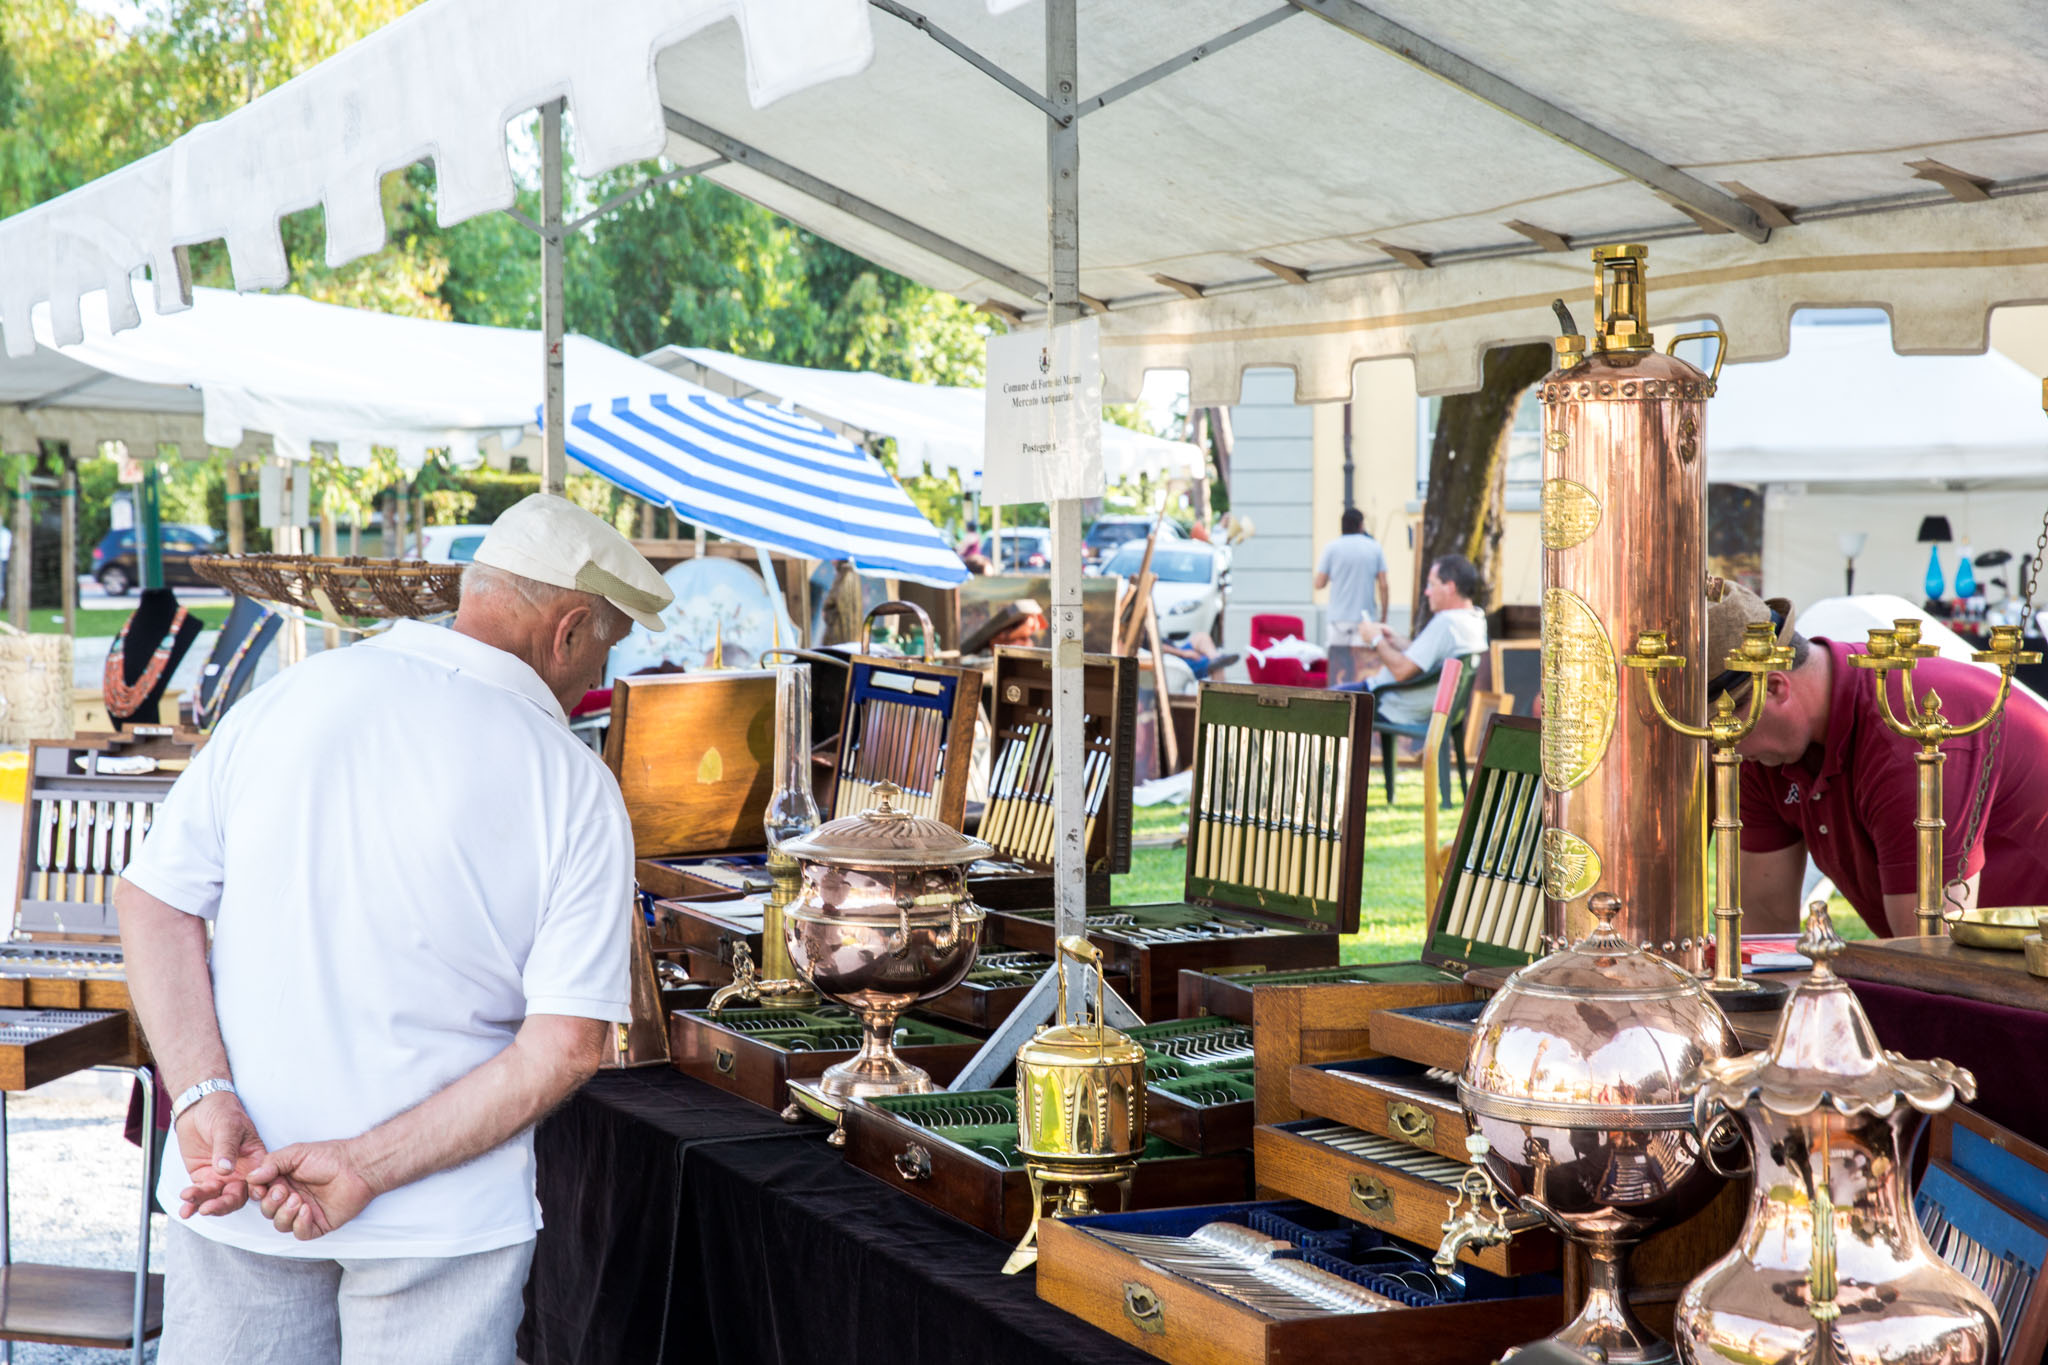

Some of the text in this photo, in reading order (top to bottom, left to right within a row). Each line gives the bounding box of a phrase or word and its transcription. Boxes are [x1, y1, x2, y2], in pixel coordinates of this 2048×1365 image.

[1003, 382, 1030, 394] Comune
[1030, 379, 1037, 390] di
[1038, 378, 1053, 390] Forte
[1012, 396, 1039, 408] Mercato
[1022, 442, 1051, 454] Posteggio
